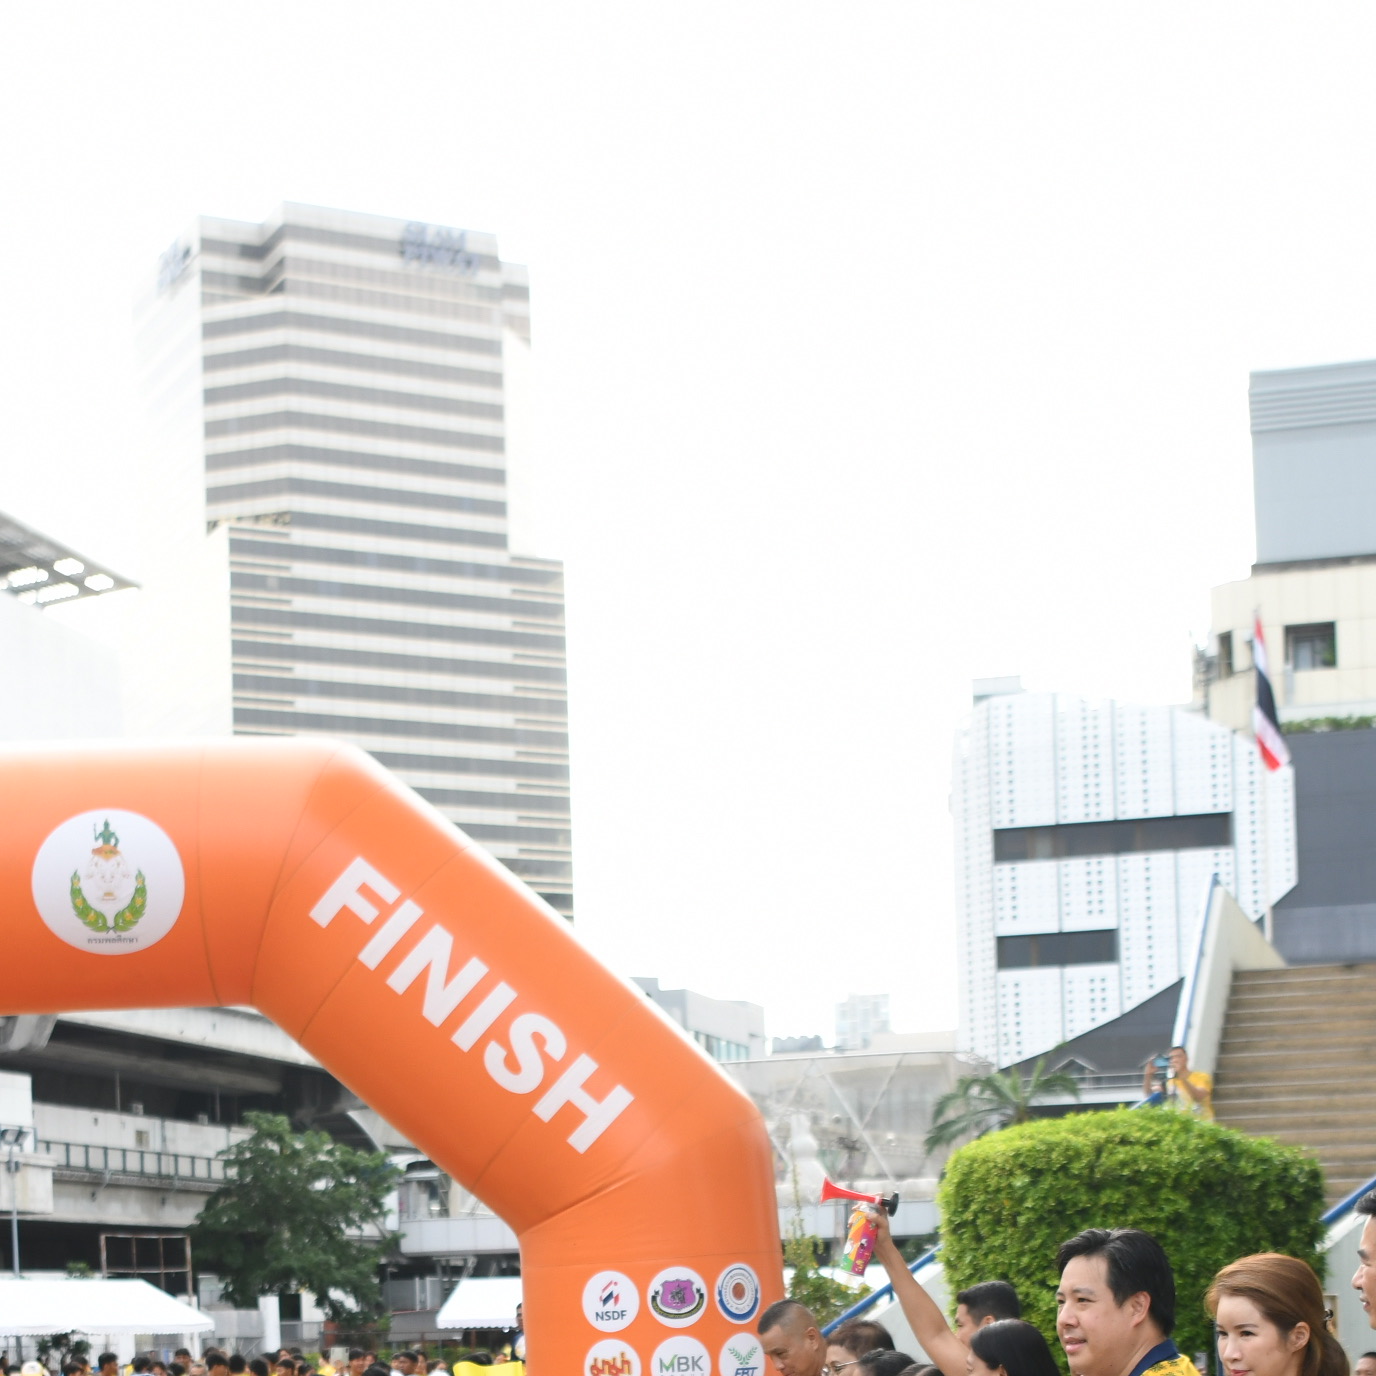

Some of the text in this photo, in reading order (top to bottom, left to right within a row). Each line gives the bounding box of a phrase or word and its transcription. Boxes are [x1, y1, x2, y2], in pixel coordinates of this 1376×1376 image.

[309, 856, 635, 1154] FINISH
[595, 1310, 627, 1322] NSDF
[658, 1354, 705, 1374] MBK
